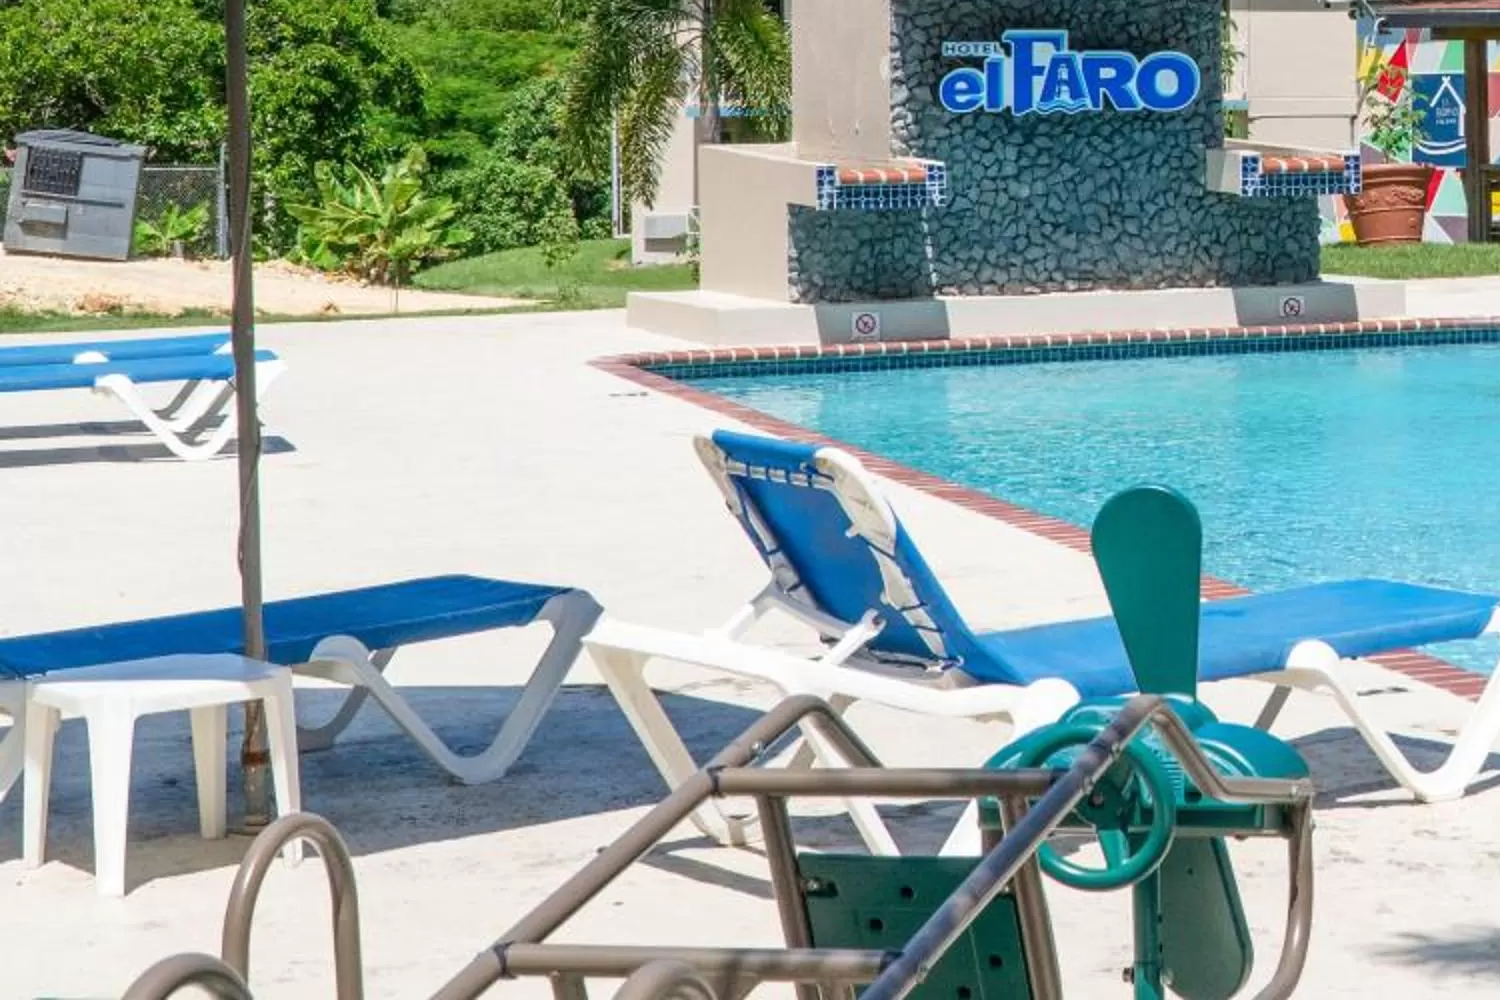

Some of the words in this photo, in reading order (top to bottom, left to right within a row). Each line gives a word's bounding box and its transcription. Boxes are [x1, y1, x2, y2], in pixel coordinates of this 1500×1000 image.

[940, 56, 1004, 112] el
[1002, 29, 1200, 115] FARO
[942, 41, 1002, 56] HOTEL
